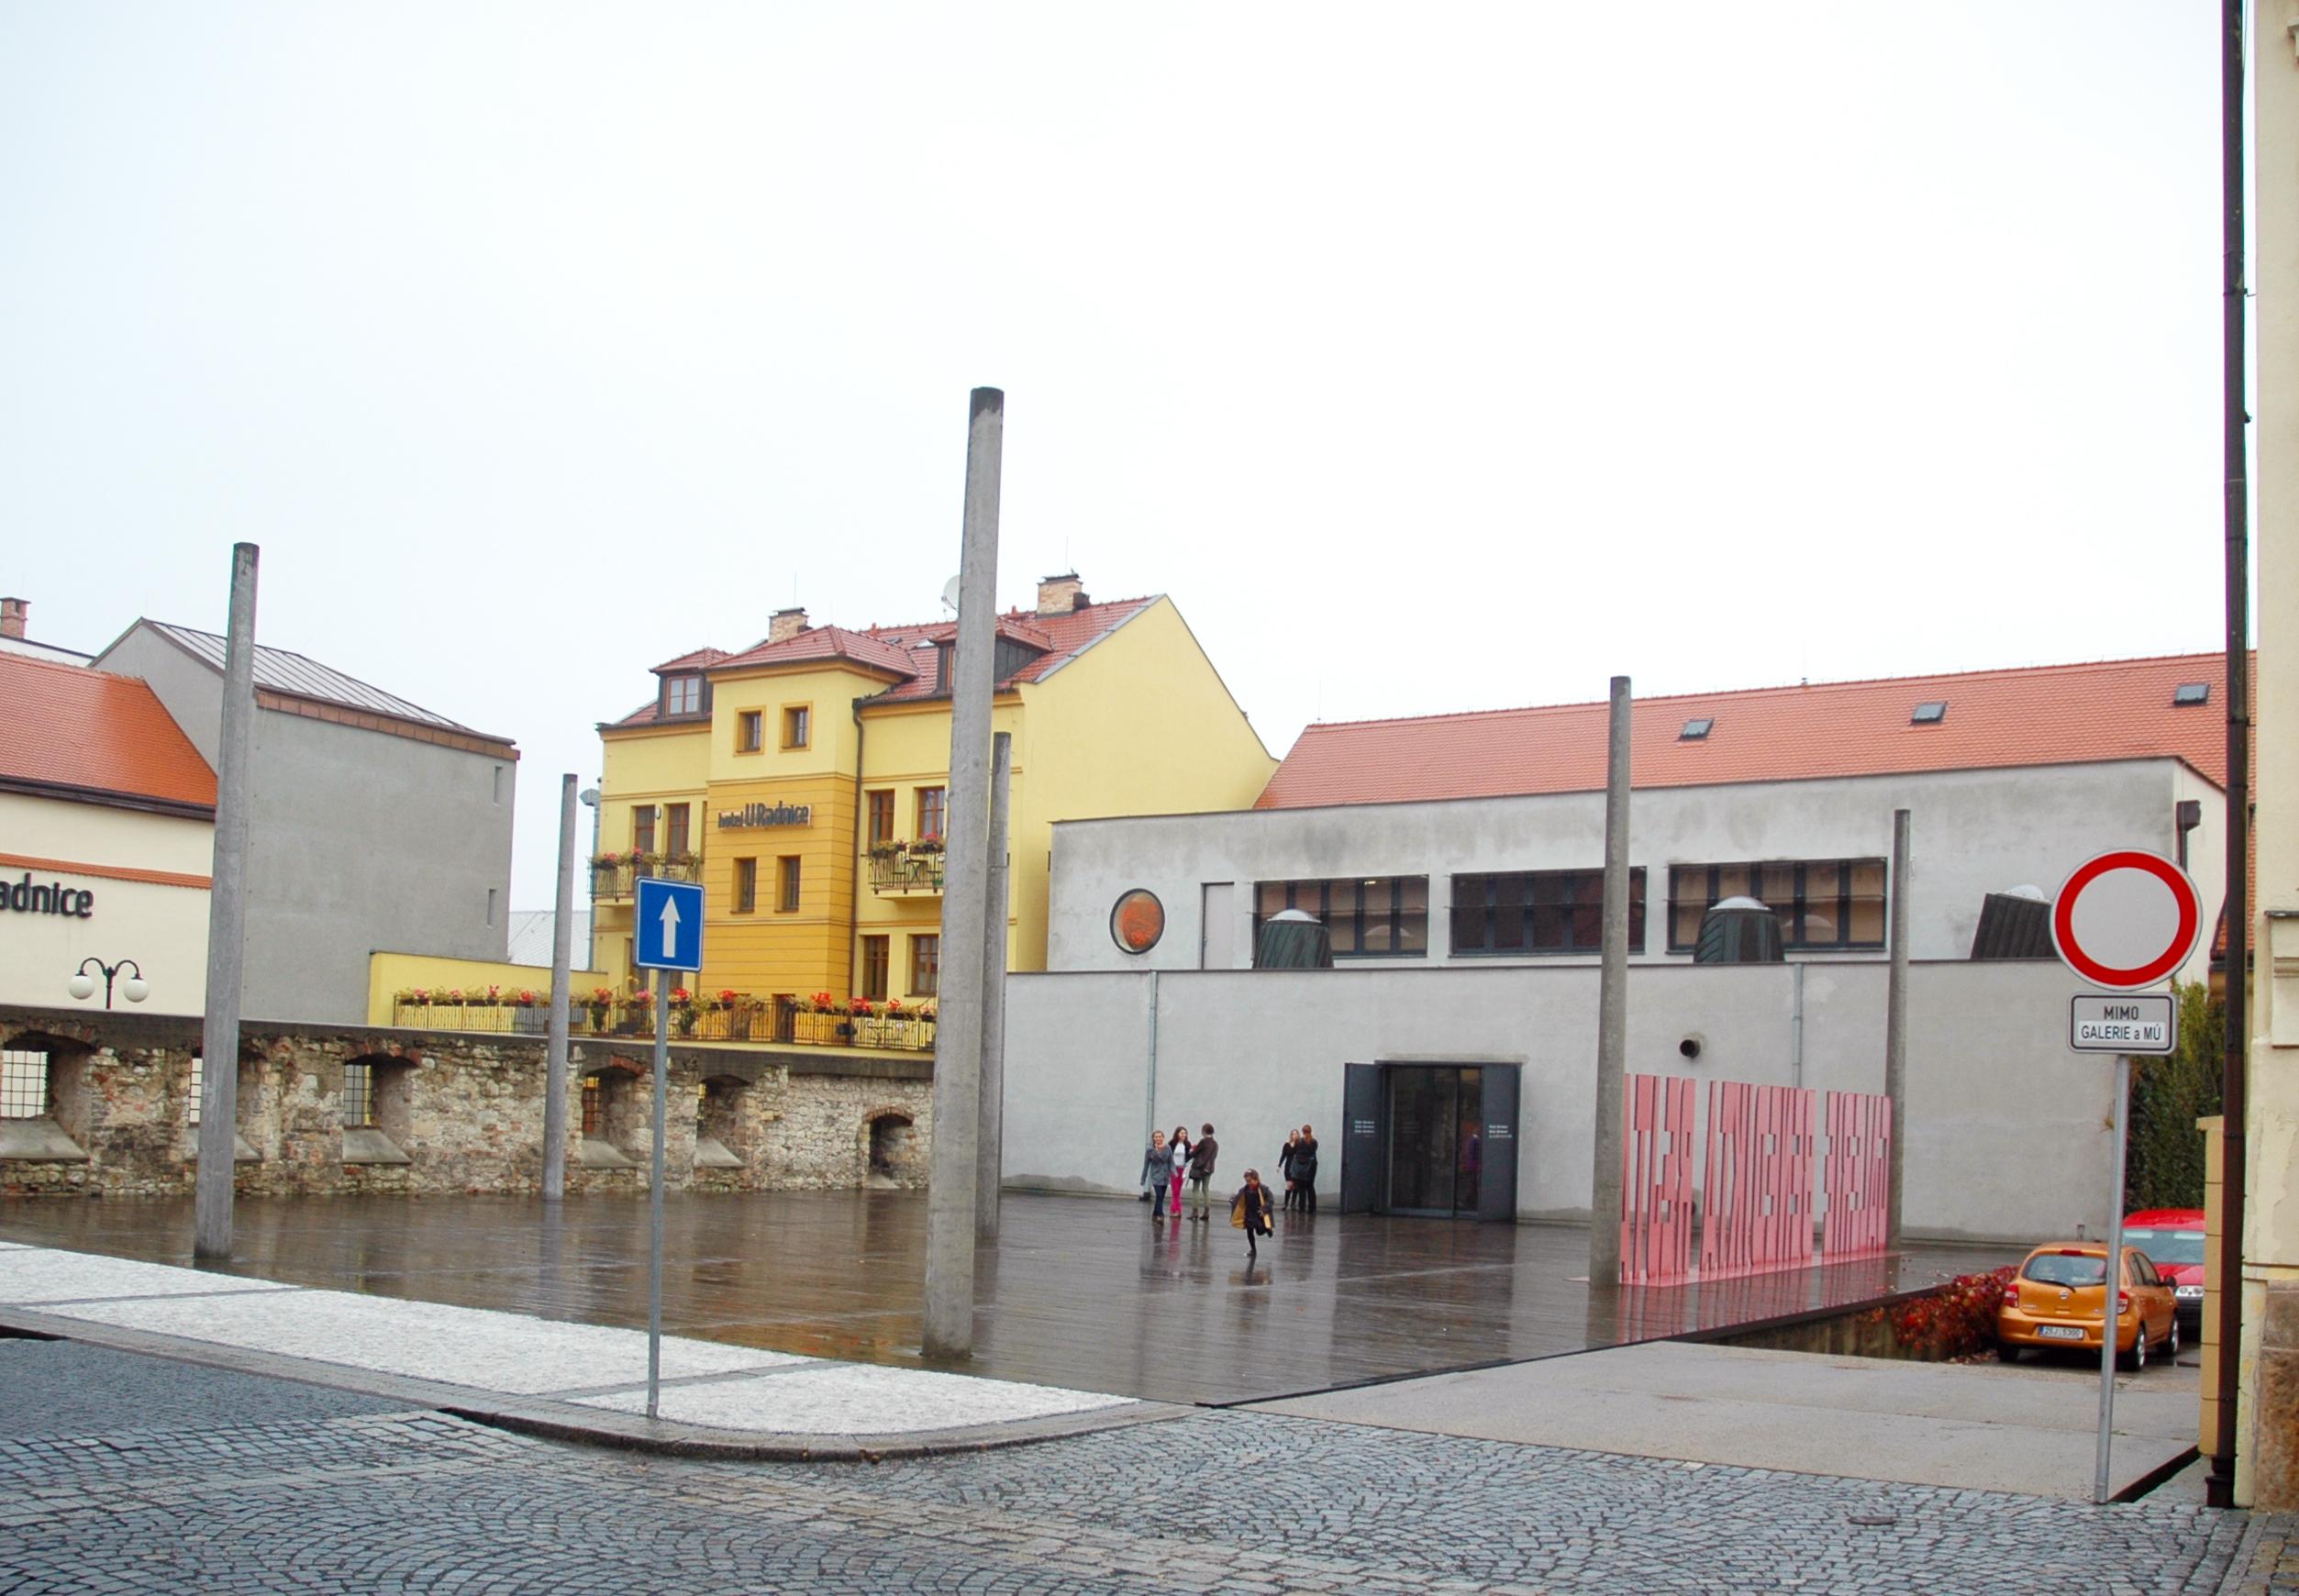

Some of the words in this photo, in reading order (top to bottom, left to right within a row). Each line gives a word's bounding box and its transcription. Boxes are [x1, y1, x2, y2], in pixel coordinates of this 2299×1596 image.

[718, 812, 743, 827] hotel
[745, 804, 755, 826] U
[757, 800, 808, 826] Radnice
[2104, 1005, 2139, 1020] MIMO
[2081, 1025, 2130, 1039] GALERIE
[2134, 1030, 2140, 1040] a
[2144, 1024, 2160, 1040] MÚ
